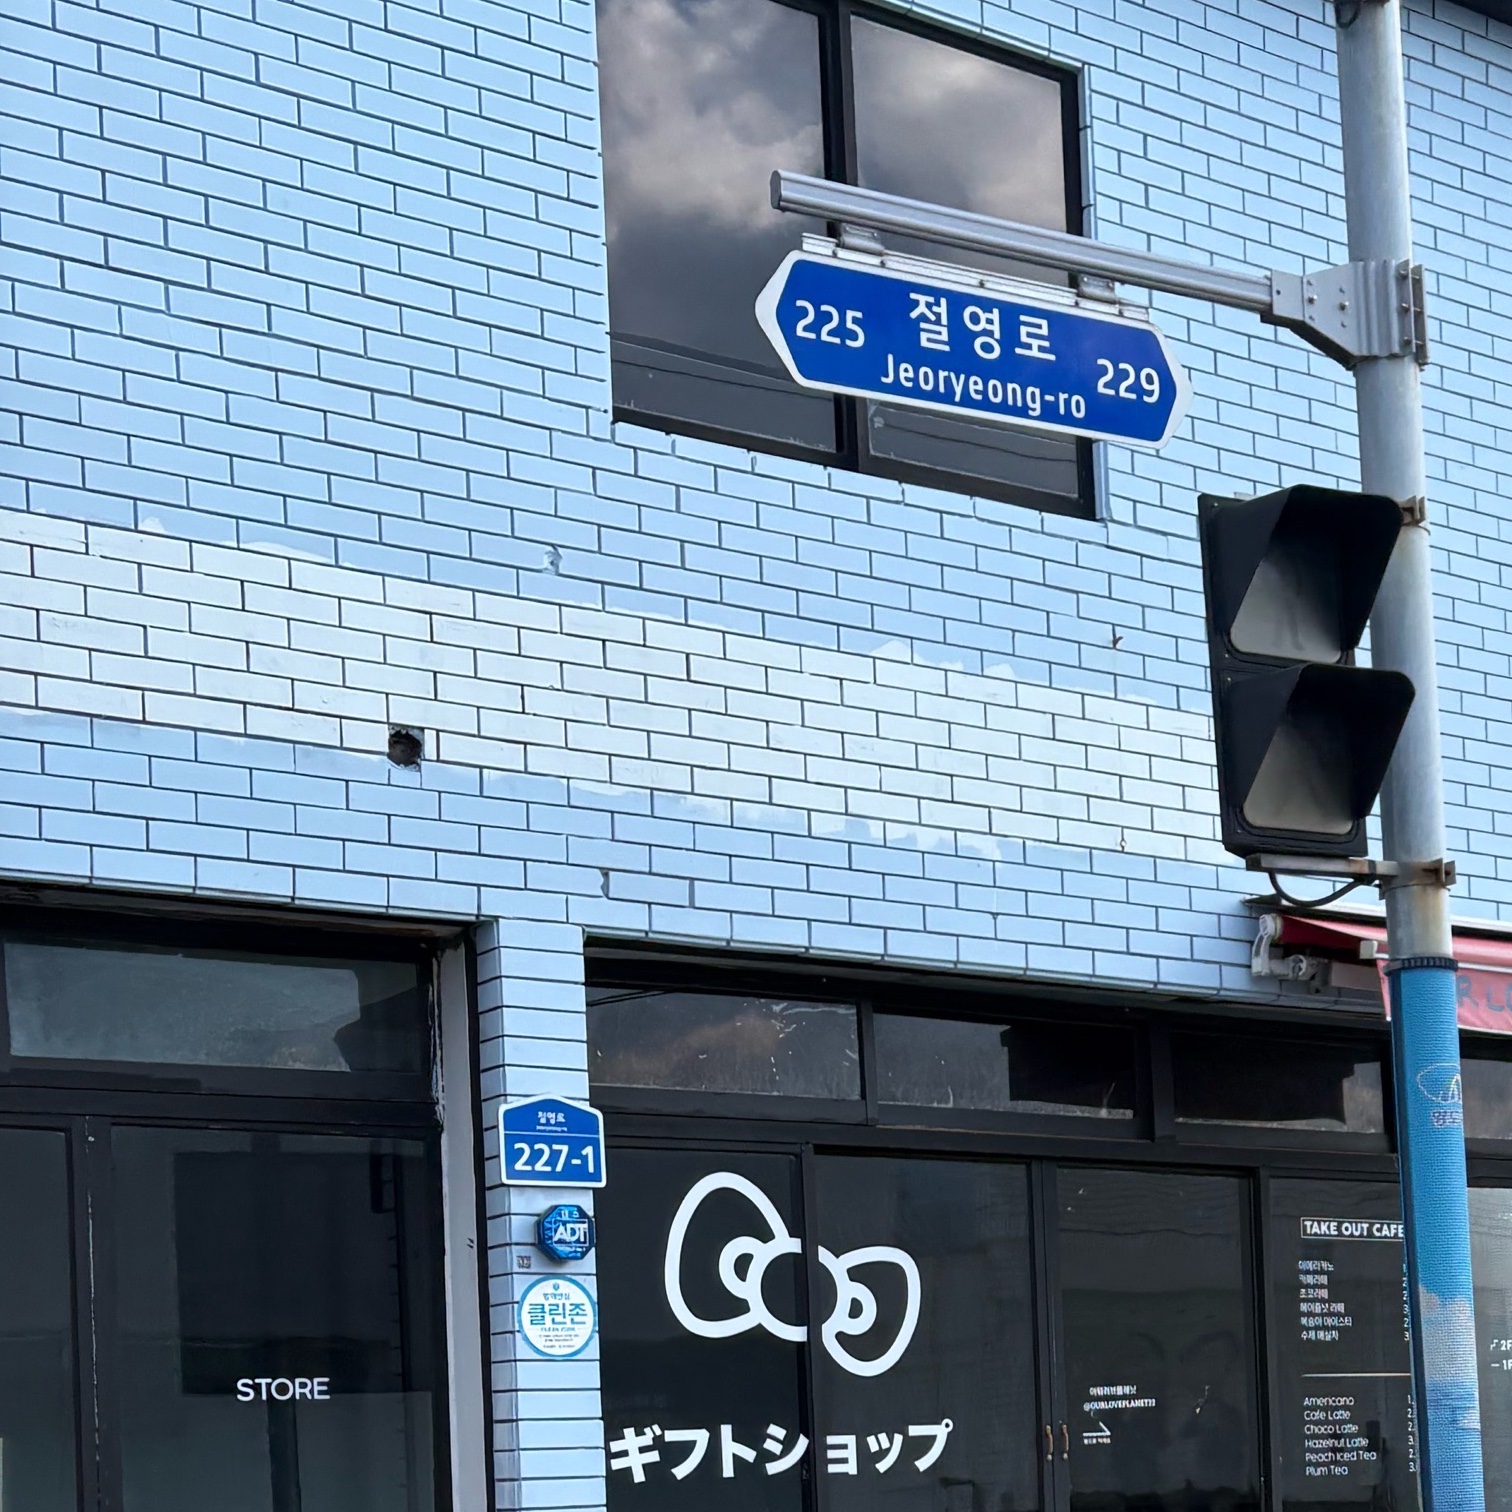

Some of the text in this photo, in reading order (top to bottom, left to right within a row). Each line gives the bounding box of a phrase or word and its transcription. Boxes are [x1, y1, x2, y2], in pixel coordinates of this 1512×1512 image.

[794, 299, 865, 348] 225
[909, 292, 1056, 361] 절영로
[880, 352, 1086, 419] Jeoryeong-ro
[1096, 358, 1160, 403] 229
[514, 1142, 594, 1174] 227-1
[553, 1222, 588, 1242] ADT
[1304, 1221, 1404, 1238] TAKE OUT CAFE
[528, 1302, 588, 1326] 클린존
[1500, 1339, 1512, 1351] 2F
[1502, 1359, 1512, 1371] 1F
[236, 1377, 331, 1402] STORE
[1303, 1396, 1355, 1407] Americano
[1303, 1409, 1326, 1421] Cafe
[1328, 1409, 1351, 1420] Latte
[1304, 1424, 1335, 1434] Choco
[1336, 1423, 1359, 1433] Latte
[609, 1418, 953, 1484] ギフトショップ
[1304, 1438, 1345, 1448] Hazelnut
[1346, 1437, 1369, 1448] Latte
[1305, 1452, 1335, 1462] Peach
[1336, 1451, 1357, 1461] Iced
[1358, 1450, 1377, 1460] Tea
[1305, 1465, 1328, 1476] Plum
[1329, 1465, 1349, 1475] Tea
